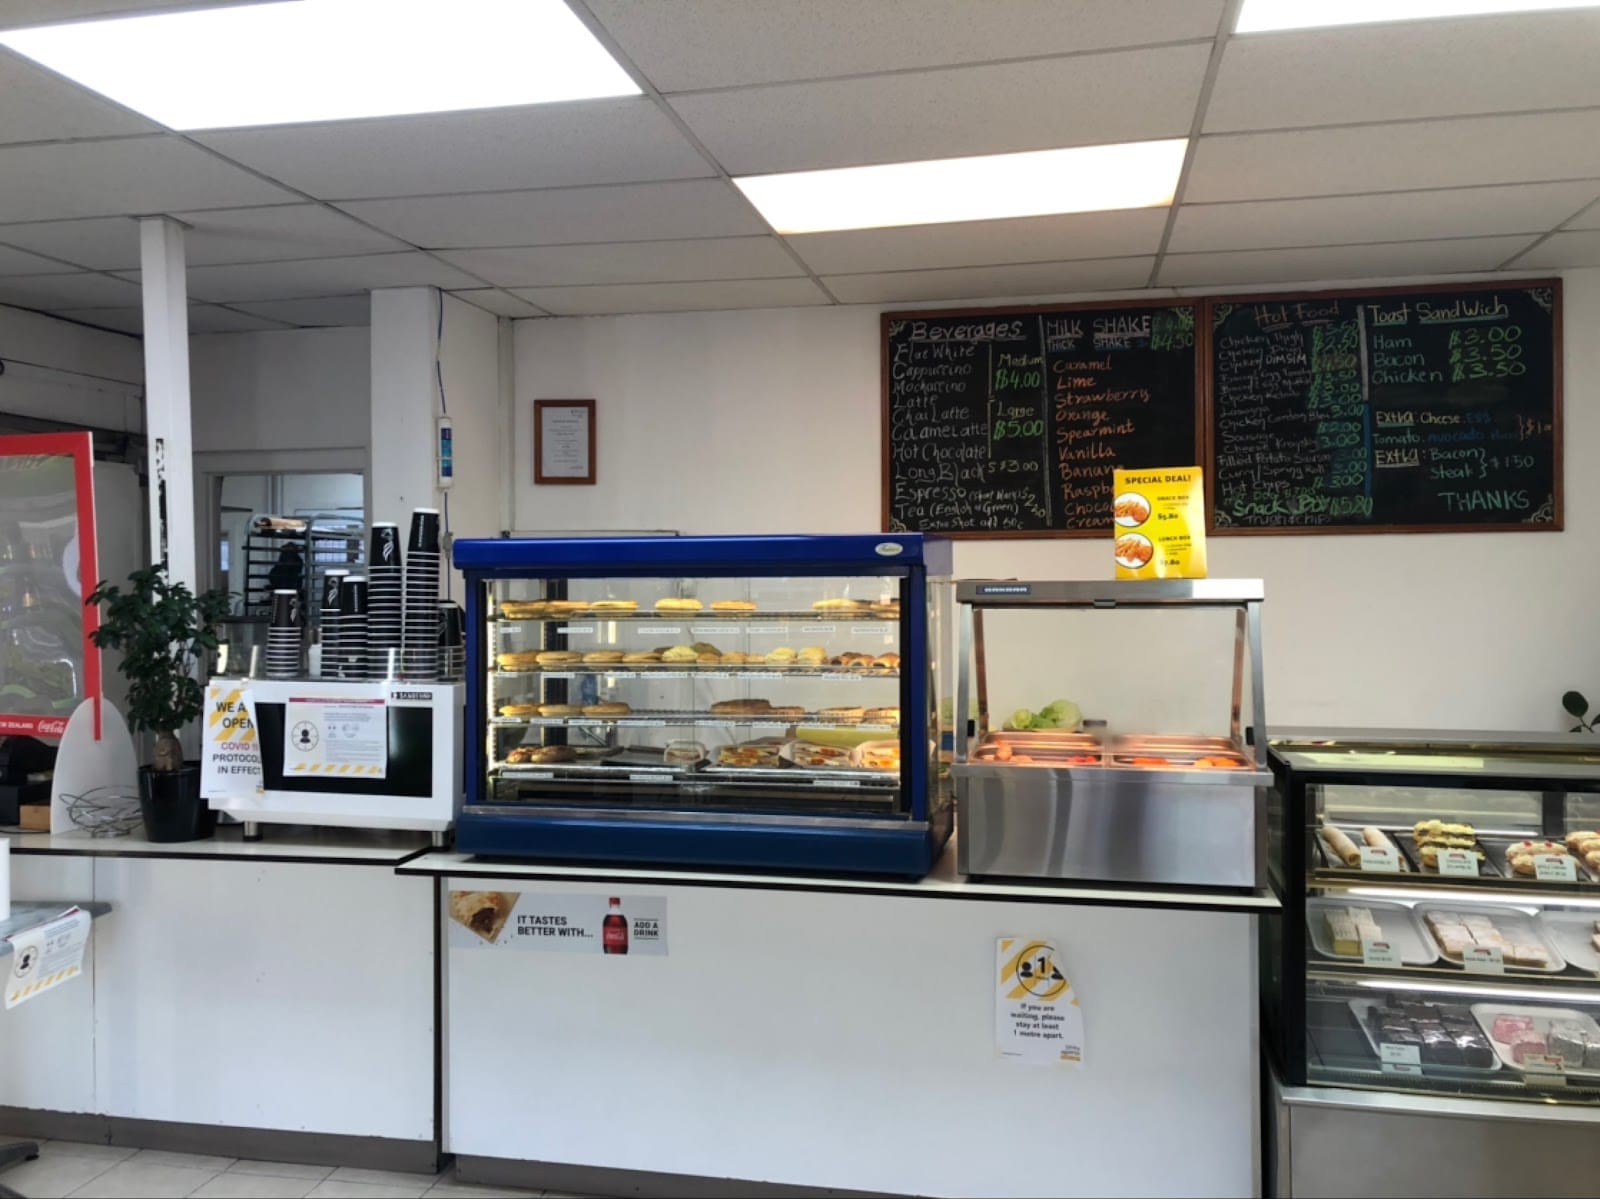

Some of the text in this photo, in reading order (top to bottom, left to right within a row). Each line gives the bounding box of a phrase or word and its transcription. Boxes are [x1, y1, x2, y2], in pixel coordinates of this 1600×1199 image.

[1254, 301, 1339, 327] Hot Food
[1367, 302, 1411, 322] Toast
[911, 321, 1023, 343] Beverages
[1093, 315, 1152, 334] SHAKE
[1373, 326, 1521, 350] Ham $3.00
[895, 341, 976, 363] Flat White
[1373, 344, 1522, 368] Bacon $3.50
[1052, 354, 1113, 374] Caramel
[1371, 361, 1526, 385] Chicken $3.50
[995, 367, 1040, 390] $4.00
[1057, 376, 1097, 391] Lime
[894, 395, 939, 409] Latte
[1054, 388, 1152, 409] Strawberry
[892, 403, 970, 425] Chai Latte
[997, 400, 1034, 420] Large
[1055, 408, 1112, 426] Orange
[993, 420, 1044, 440] $5.00
[1056, 418, 1136, 445] Spearmint
[892, 443, 919, 461] Hot
[1058, 441, 1117, 461] Vanilla
[896, 461, 937, 482] Long
[937, 462, 985, 486] Black
[1125, 474, 1192, 485] SPECIAL DEAL!
[896, 482, 966, 503] Espresso
[1221, 482, 1248, 497] Hot
[896, 502, 925, 519] Tea
[1232, 495, 1288, 517] Snack
[1437, 490, 1531, 512] THANKS
[216, 701, 234, 713] WE
[221, 742, 250, 751] COVID
[217, 766, 228, 775] IN
[517, 915, 568, 926] IT TASTES
[634, 921, 658, 929] ADD A
[517, 926, 555, 937] BETTER
[633, 929, 659, 937] DRINK
[1037, 956, 1046, 974] 1
[1028, 1004, 1041, 1012] you
[1041, 1013, 1065, 1022] please
[1016, 1020, 1059, 1030] stay at least
[1019, 1030, 1041, 1038] metre
[1043, 1031, 1064, 1040] apart.
